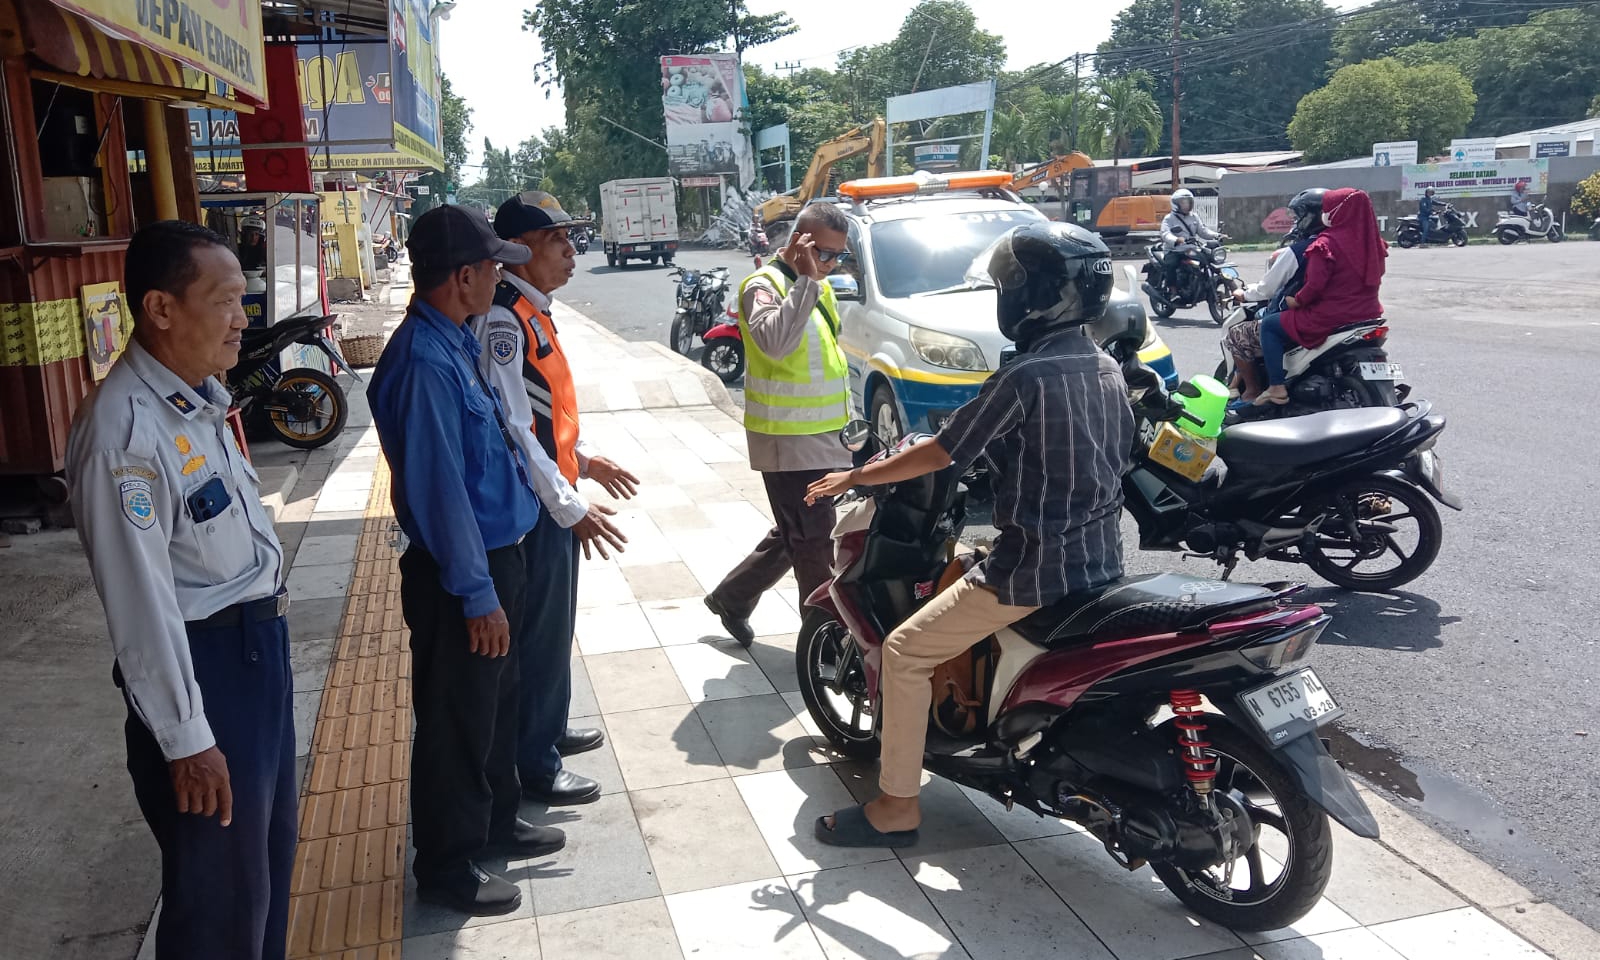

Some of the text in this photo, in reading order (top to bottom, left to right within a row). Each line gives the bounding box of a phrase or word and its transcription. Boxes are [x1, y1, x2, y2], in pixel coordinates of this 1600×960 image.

[204, 19, 256, 87] ERATEX
[1449, 170, 1498, 180] SELAMAT DATANG
[1267, 681, 1301, 709] 6755
